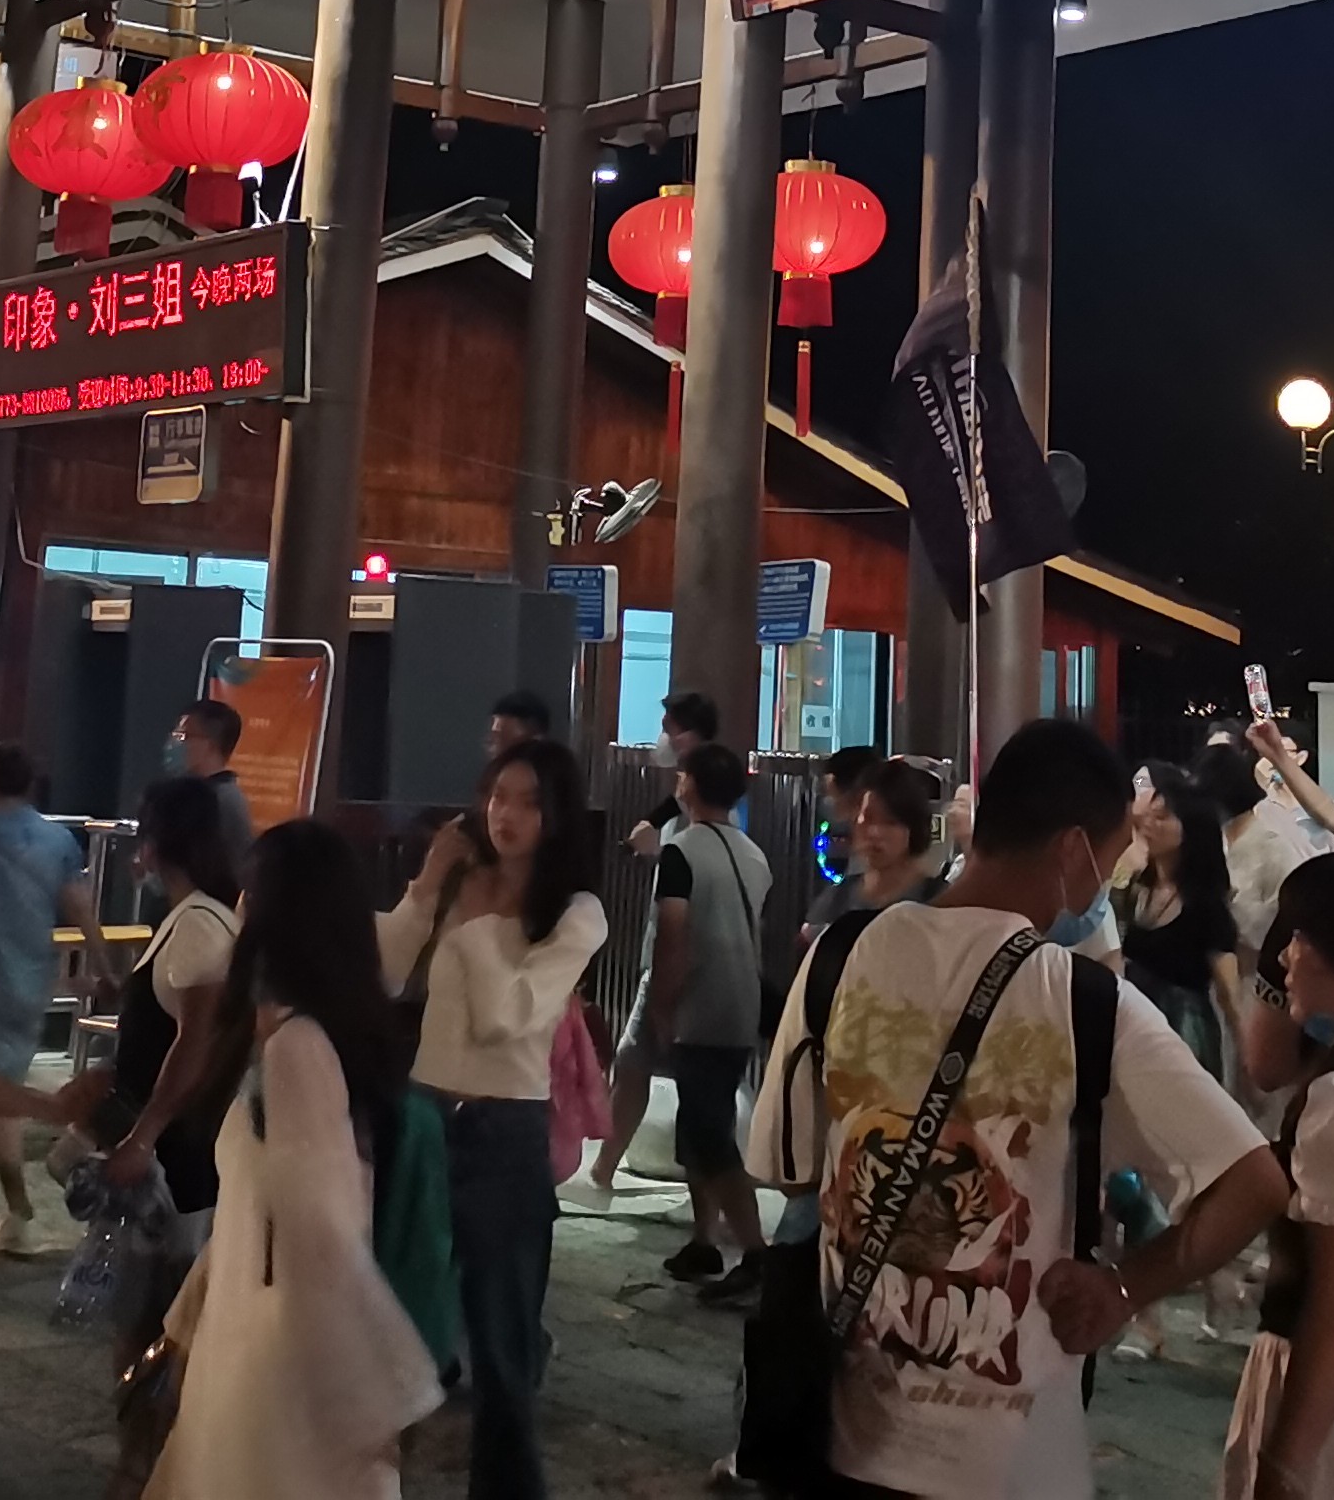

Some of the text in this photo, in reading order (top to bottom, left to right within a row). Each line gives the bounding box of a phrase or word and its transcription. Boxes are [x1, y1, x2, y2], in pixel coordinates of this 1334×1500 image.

[4, 256, 277, 352] 印象·刘三姐 今晚两场
